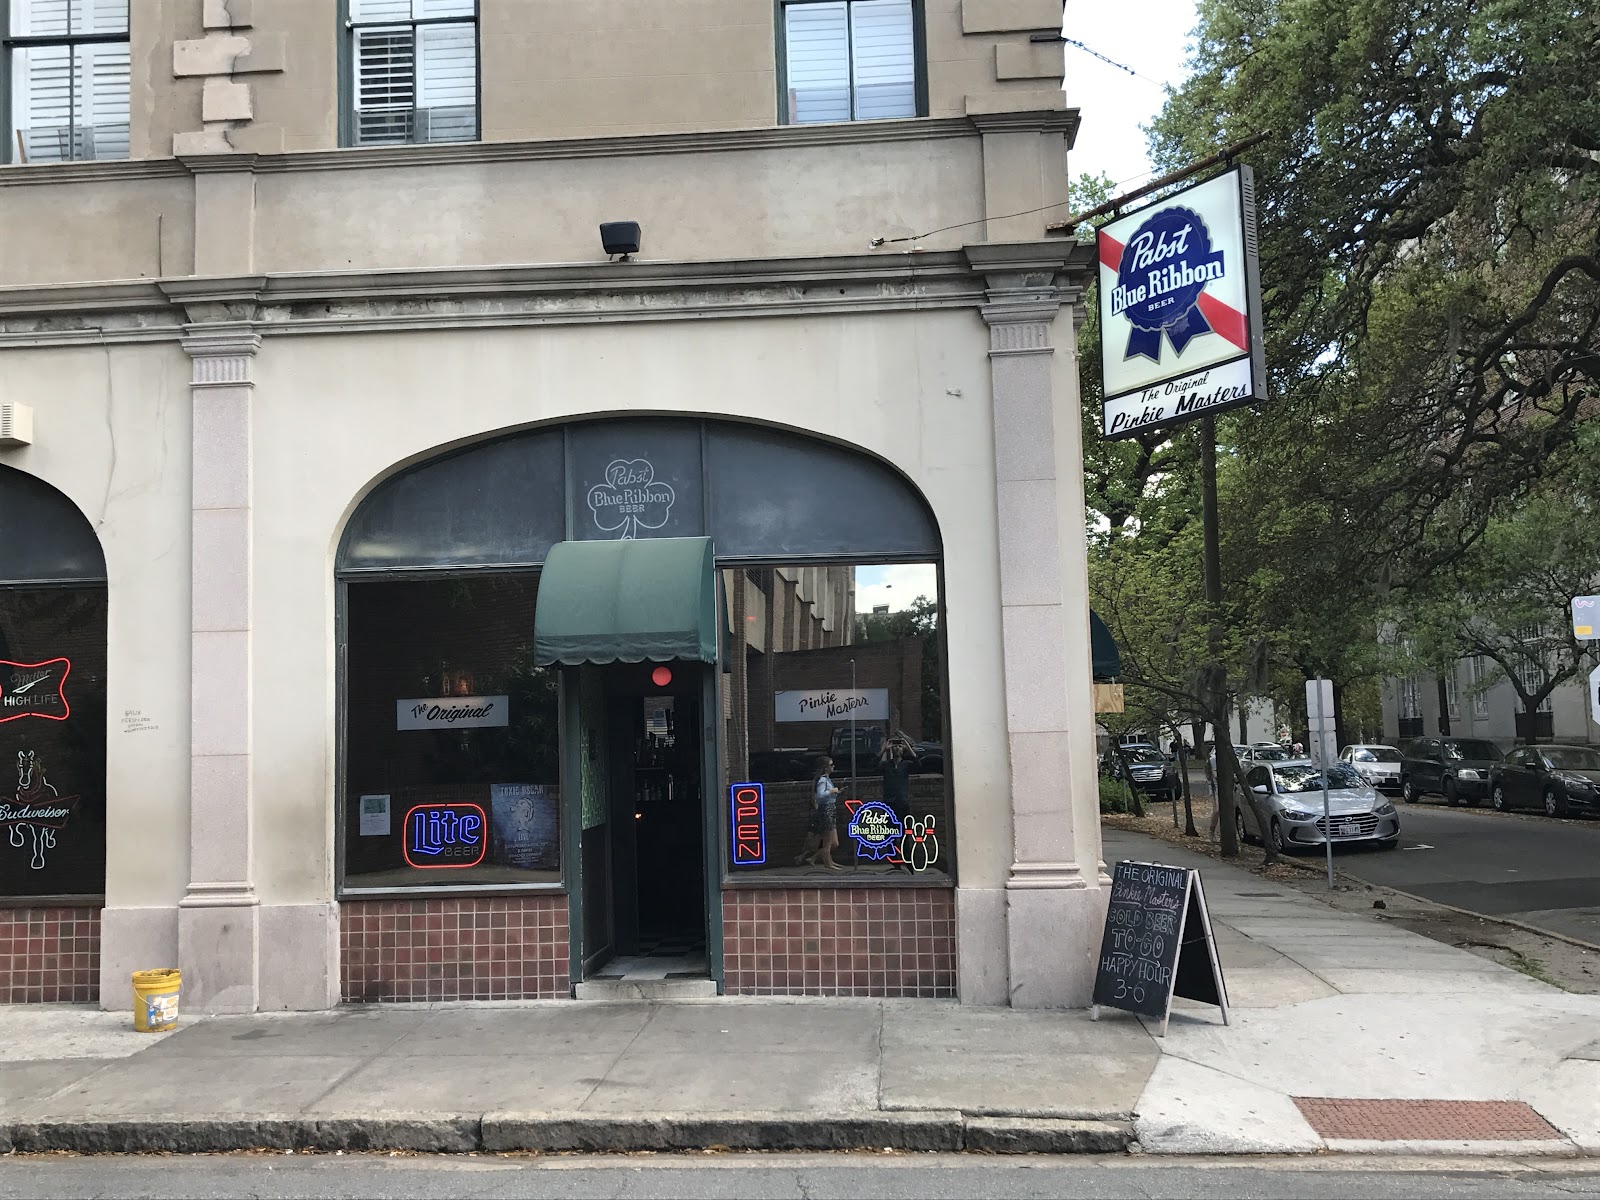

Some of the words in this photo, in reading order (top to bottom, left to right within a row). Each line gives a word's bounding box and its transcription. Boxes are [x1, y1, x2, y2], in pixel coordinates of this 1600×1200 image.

[1131, 223, 1193, 273] Pabst
[1112, 285, 1147, 316] Blue
[1148, 260, 1224, 298] Ribbon
[1148, 297, 1175, 312] BEER
[1140, 388, 1160, 404] The
[1164, 371, 1210, 396] Original
[1110, 406, 1164, 434] Pinkie
[1175, 383, 1248, 415] Masters
[610, 465, 650, 486] Pabst
[594, 491, 623, 507] Blue
[624, 488, 671, 505] Ribbon
[619, 504, 645, 514] BEER
[10, 669, 52, 688] Miller
[4, 695, 31, 707] HIGH
[33, 693, 59, 705] LIFE
[798, 691, 838, 713] Pinkie
[826, 696, 869, 719] Masters
[411, 703, 429, 719] The
[426, 702, 494, 723] Original
[0, 804, 70, 821] Budweiser
[860, 809, 889, 824] Pabst
[413, 811, 481, 855] Lite
[736, 789, 761, 858] OPEN
[851, 824, 870, 835] Blue
[870, 824, 900, 836] Ribbon
[444, 845, 480, 858] BEER
[1116, 865, 1140, 881] THE
[1141, 869, 1186, 890] ORIGINAL
[1112, 881, 1143, 901] Pinkie
[1108, 908, 1143, 927] COLD
[1145, 911, 1178, 936] BEER
[1111, 928, 1165, 959] TO-GO
[1101, 956, 1138, 977] HAPPY
[1138, 962, 1171, 987] HOUR
